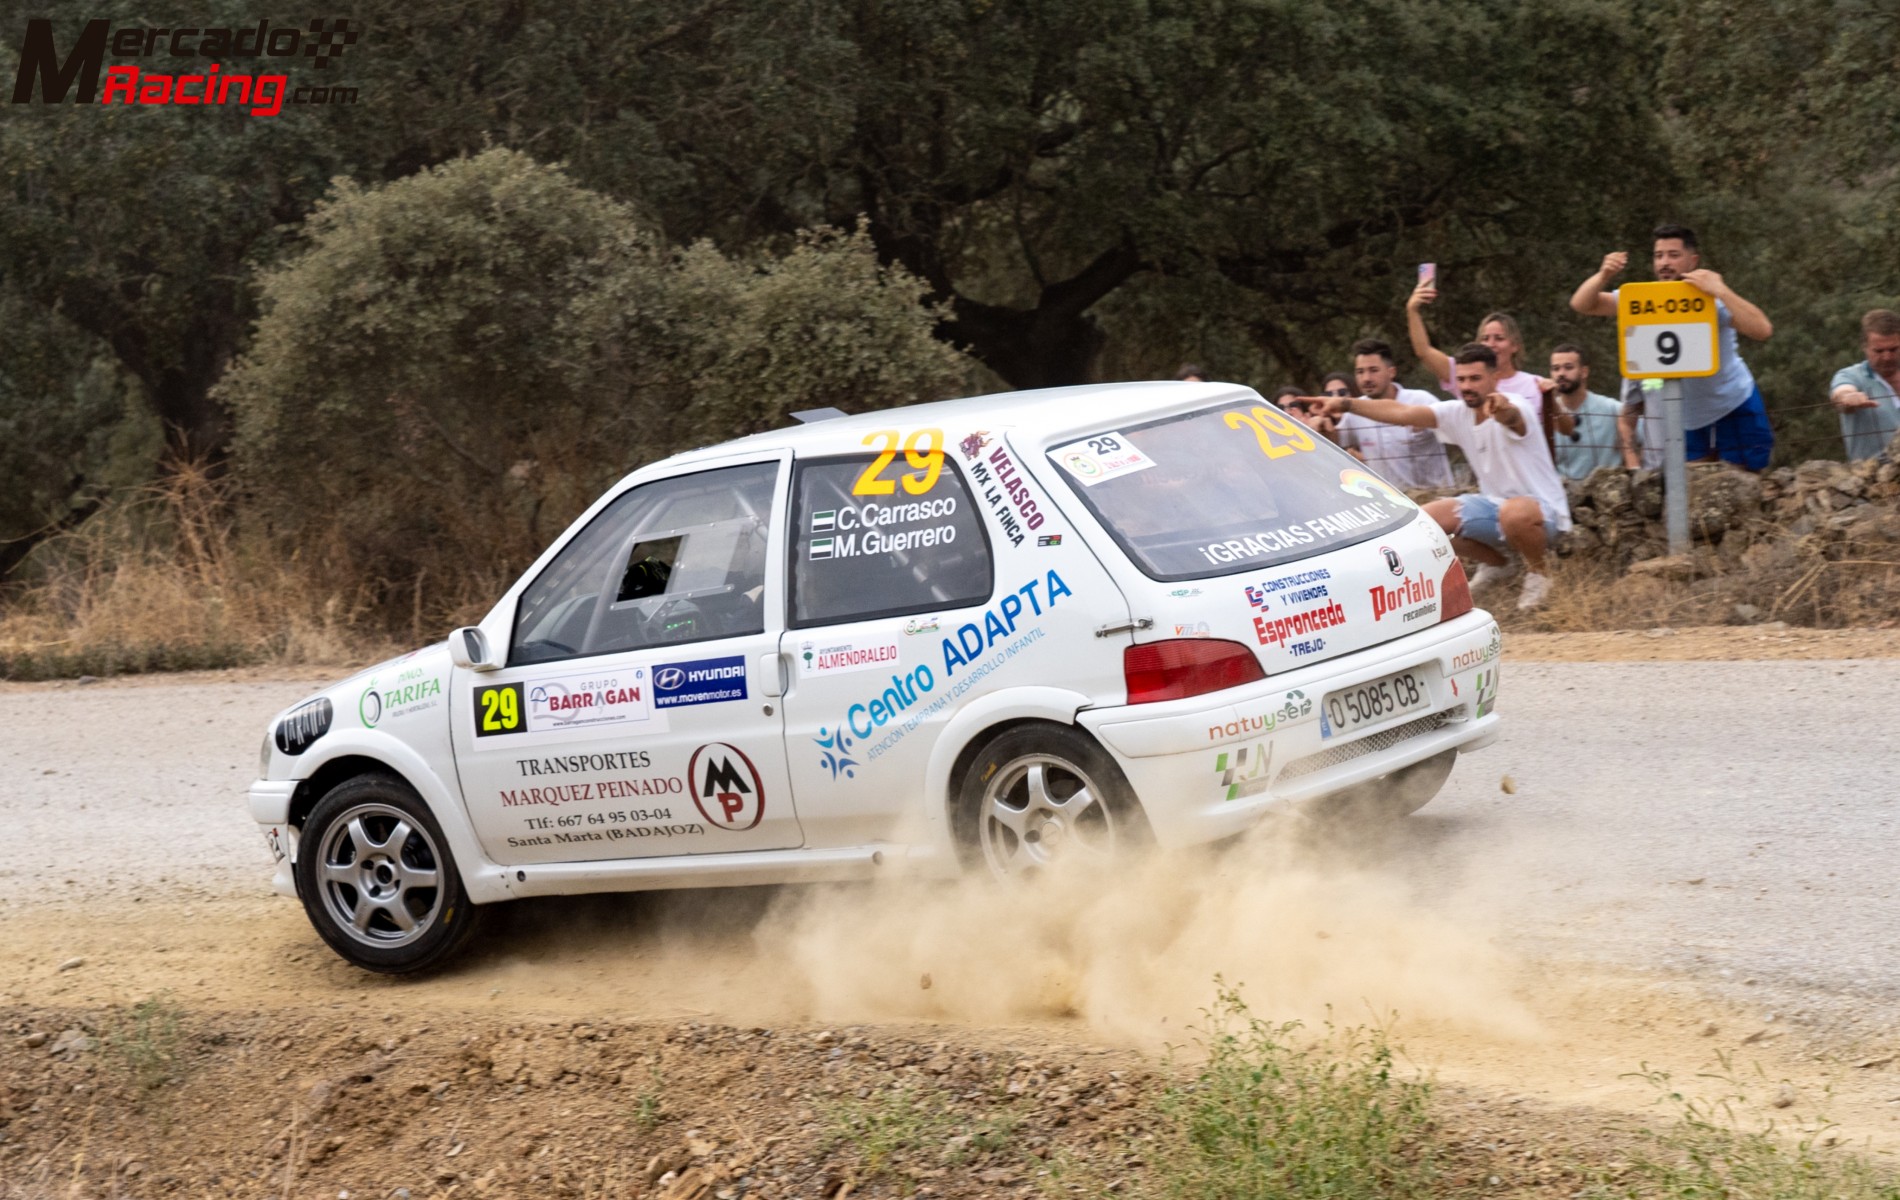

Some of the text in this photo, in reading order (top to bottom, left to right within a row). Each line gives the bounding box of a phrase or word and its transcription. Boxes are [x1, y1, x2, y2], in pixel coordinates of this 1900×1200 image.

[1629, 298, 1706, 315] BA-030
[1656, 331, 1682, 365] 9
[1088, 436, 1121, 455] 29
[1222, 406, 1316, 460] 29
[852, 427, 945, 496] 29
[971, 461, 1025, 548] MX LA FINCA
[988, 446, 1045, 531] VELASCO
[837, 497, 957, 531] C.Carrasco
[834, 524, 956, 558] M.Guerrero
[1199, 502, 1390, 566] ¡GRACIAS FAMILIA!
[1262, 568, 1331, 593] CONSTRUCCIONES
[1280, 585, 1328, 605] Y VIVIENDAS
[1369, 572, 1435, 621] Portalo
[941, 569, 1072, 676] ADAPTA
[1253, 598, 1347, 648] Espronceda
[1402, 602, 1438, 623] recambios
[688, 665, 745, 683] HYUNDAI
[818, 645, 897, 670] ALMENDRALEJO
[945, 690, 953, 702] Y
[952, 652, 1006, 698] DESARROLLO
[1005, 627, 1045, 658] INFANTIL
[384, 678, 441, 709] TARIFA
[550, 687, 641, 711] BARRAGAN
[580, 678, 618, 691] GRUPO
[656, 688, 742, 706] www.mavenmotor.es
[1344, 682, 1394, 723] 5085
[1394, 674, 1420, 708] CB
[481, 687, 519, 732] 29
[847, 664, 934, 740] Centro
[1208, 700, 1312, 740] natuyser
[516, 751, 651, 776] TRANSPORTES
[500, 777, 683, 808] MARQUEZ PEINADO
[558, 814, 583, 828] 667
[587, 812, 604, 825] 64
[609, 811, 627, 824] 95
[630, 808, 673, 822] 03-04
[507, 823, 705, 848] Santa Marta (BADAJOZ)
